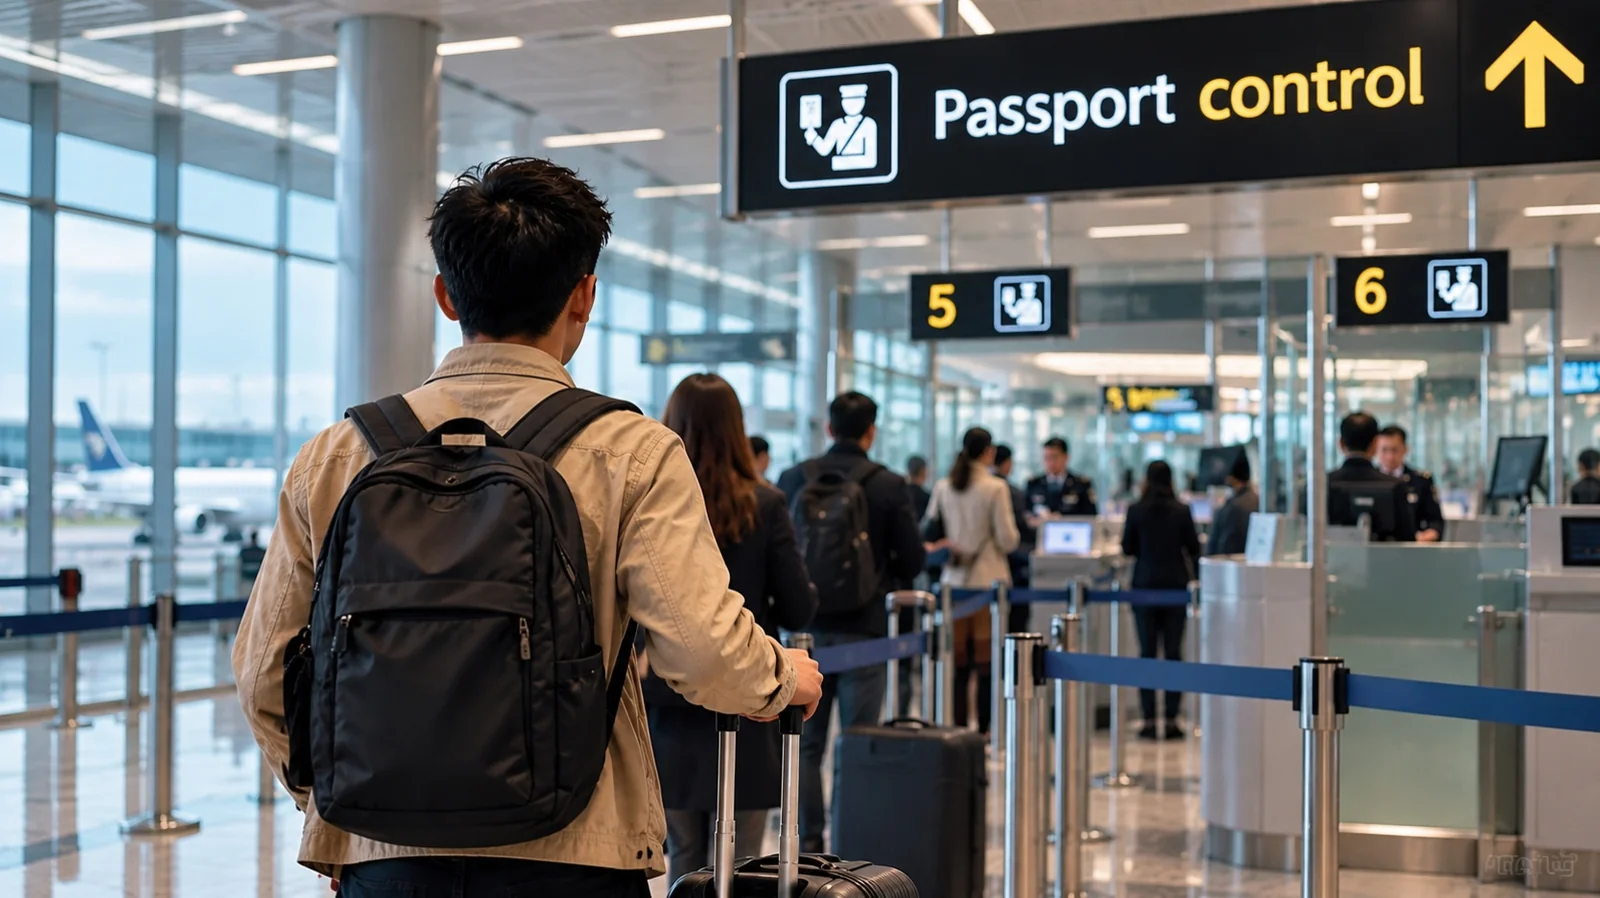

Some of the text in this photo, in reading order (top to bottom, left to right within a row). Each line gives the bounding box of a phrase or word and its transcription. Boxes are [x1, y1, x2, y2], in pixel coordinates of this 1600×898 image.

[935, 47, 1424, 145] Passport control
[928, 284, 956, 328] 5
[1354, 267, 1387, 315] 6
